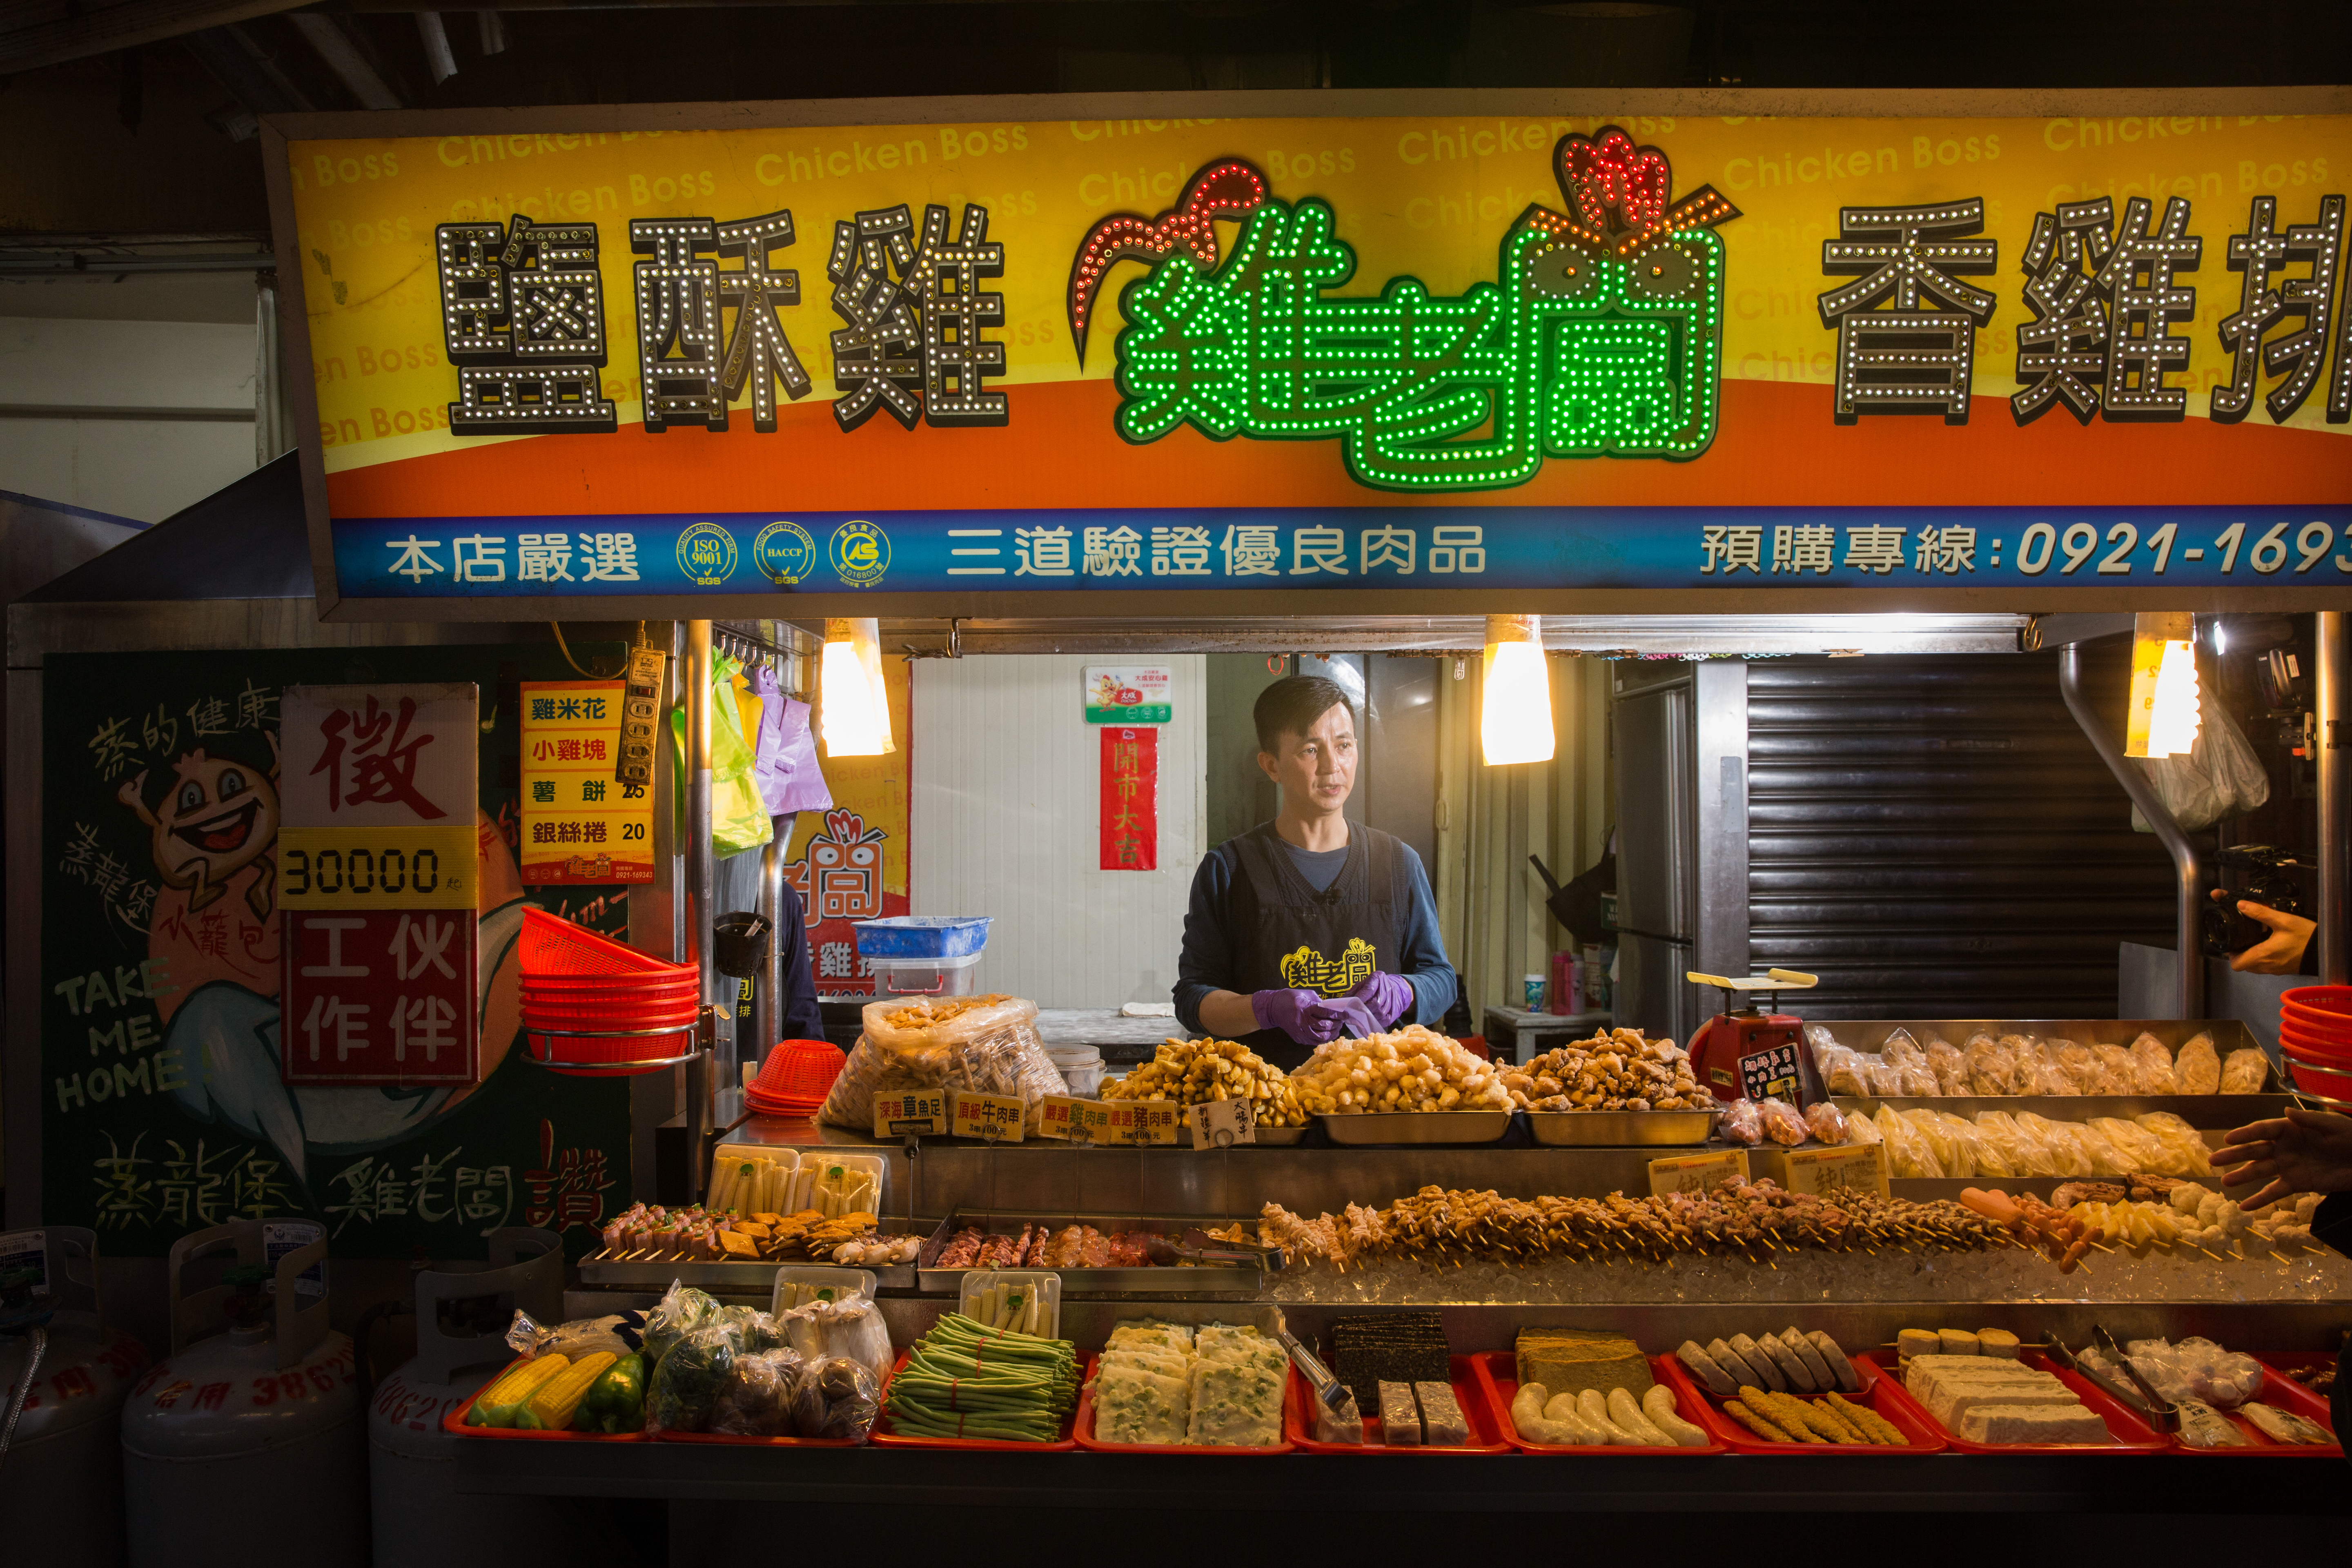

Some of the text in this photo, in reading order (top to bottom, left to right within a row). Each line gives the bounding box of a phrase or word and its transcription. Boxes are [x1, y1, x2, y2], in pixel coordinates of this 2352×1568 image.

[314, 152, 399, 187] Boss
[755, 139, 929, 187] Chicken
[940, 125, 1029, 161] Boss
[1267, 147, 1356, 182] Boss
[1724, 134, 2001, 191] Chicken Boss
[629, 171, 716, 206] Boss
[2238, 157, 2329, 193] Boss
[328, 216, 412, 250] Boss
[437, 204, 1008, 433] 鹽酥雞
[355, 343, 439, 377] Boss
[1114, 197, 1725, 492] 雞老闆
[678, 525, 735, 554] QUALITY ASSURED FIRM
[693, 539, 719, 552] ISO
[756, 525, 814, 551] FOOD SAFETY SYSTEM
[839, 523, 879, 539] 優良食品
[386, 533, 641, 584] 本店嚴選
[692, 552, 722, 565] 9001
[767, 548, 803, 557] HACCP
[947, 524, 1486, 577] 三道驗證優良肉品
[697, 577, 721, 585] SGS
[775, 576, 799, 585] SGS
[532, 697, 606, 720] 雞米花
[1120, 690, 1136, 699] 大成
[309, 693, 448, 820] 徵
[533, 739, 607, 761] 小雞塊
[1114, 742, 1143, 864] 開市大吉
[533, 821, 645, 844] 銀絲捲 20
[285, 849, 438, 895] 30000
[55, 957, 180, 1016] TAKE
[89, 1014, 161, 1057] ME
[880, 1095, 940, 1119] 深海章魚足
[958, 1100, 1019, 1124] 頂級牛肉串
[1045, 1103, 1107, 1127] 嚴選雞肉串
[1110, 1107, 1172, 1127] 嚴選豬肉串
[325, 1146, 514, 1241] 雞老闆
[524, 1118, 617, 1240] 讚
